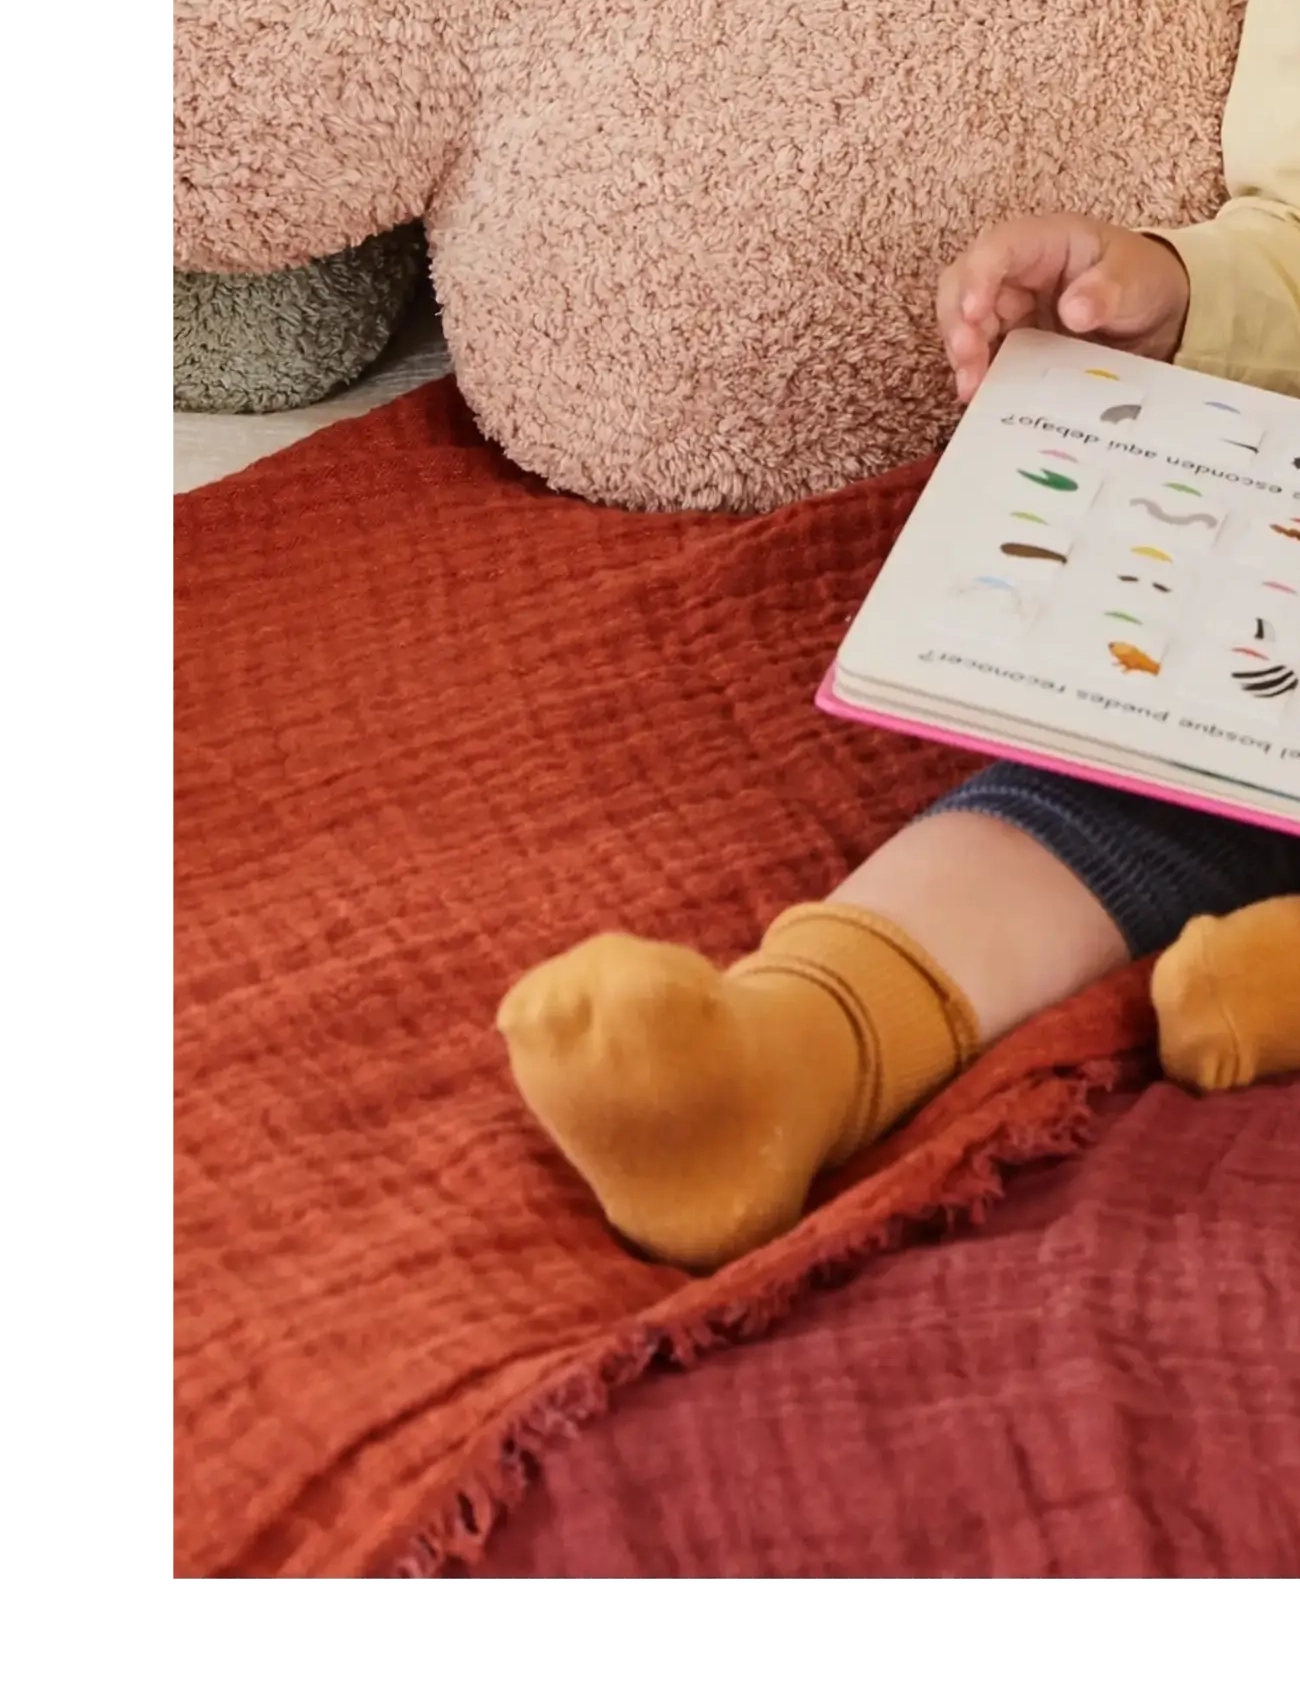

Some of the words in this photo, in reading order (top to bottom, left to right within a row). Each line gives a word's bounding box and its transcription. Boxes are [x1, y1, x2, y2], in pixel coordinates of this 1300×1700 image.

[1001, 413, 1100, 444] debajo?
[1166, 455, 1283, 494] esconden
[918, 650, 1066, 694] reconocer?
[1075, 689, 1170, 723] puedes
[1178, 717, 1272, 754] bosque
